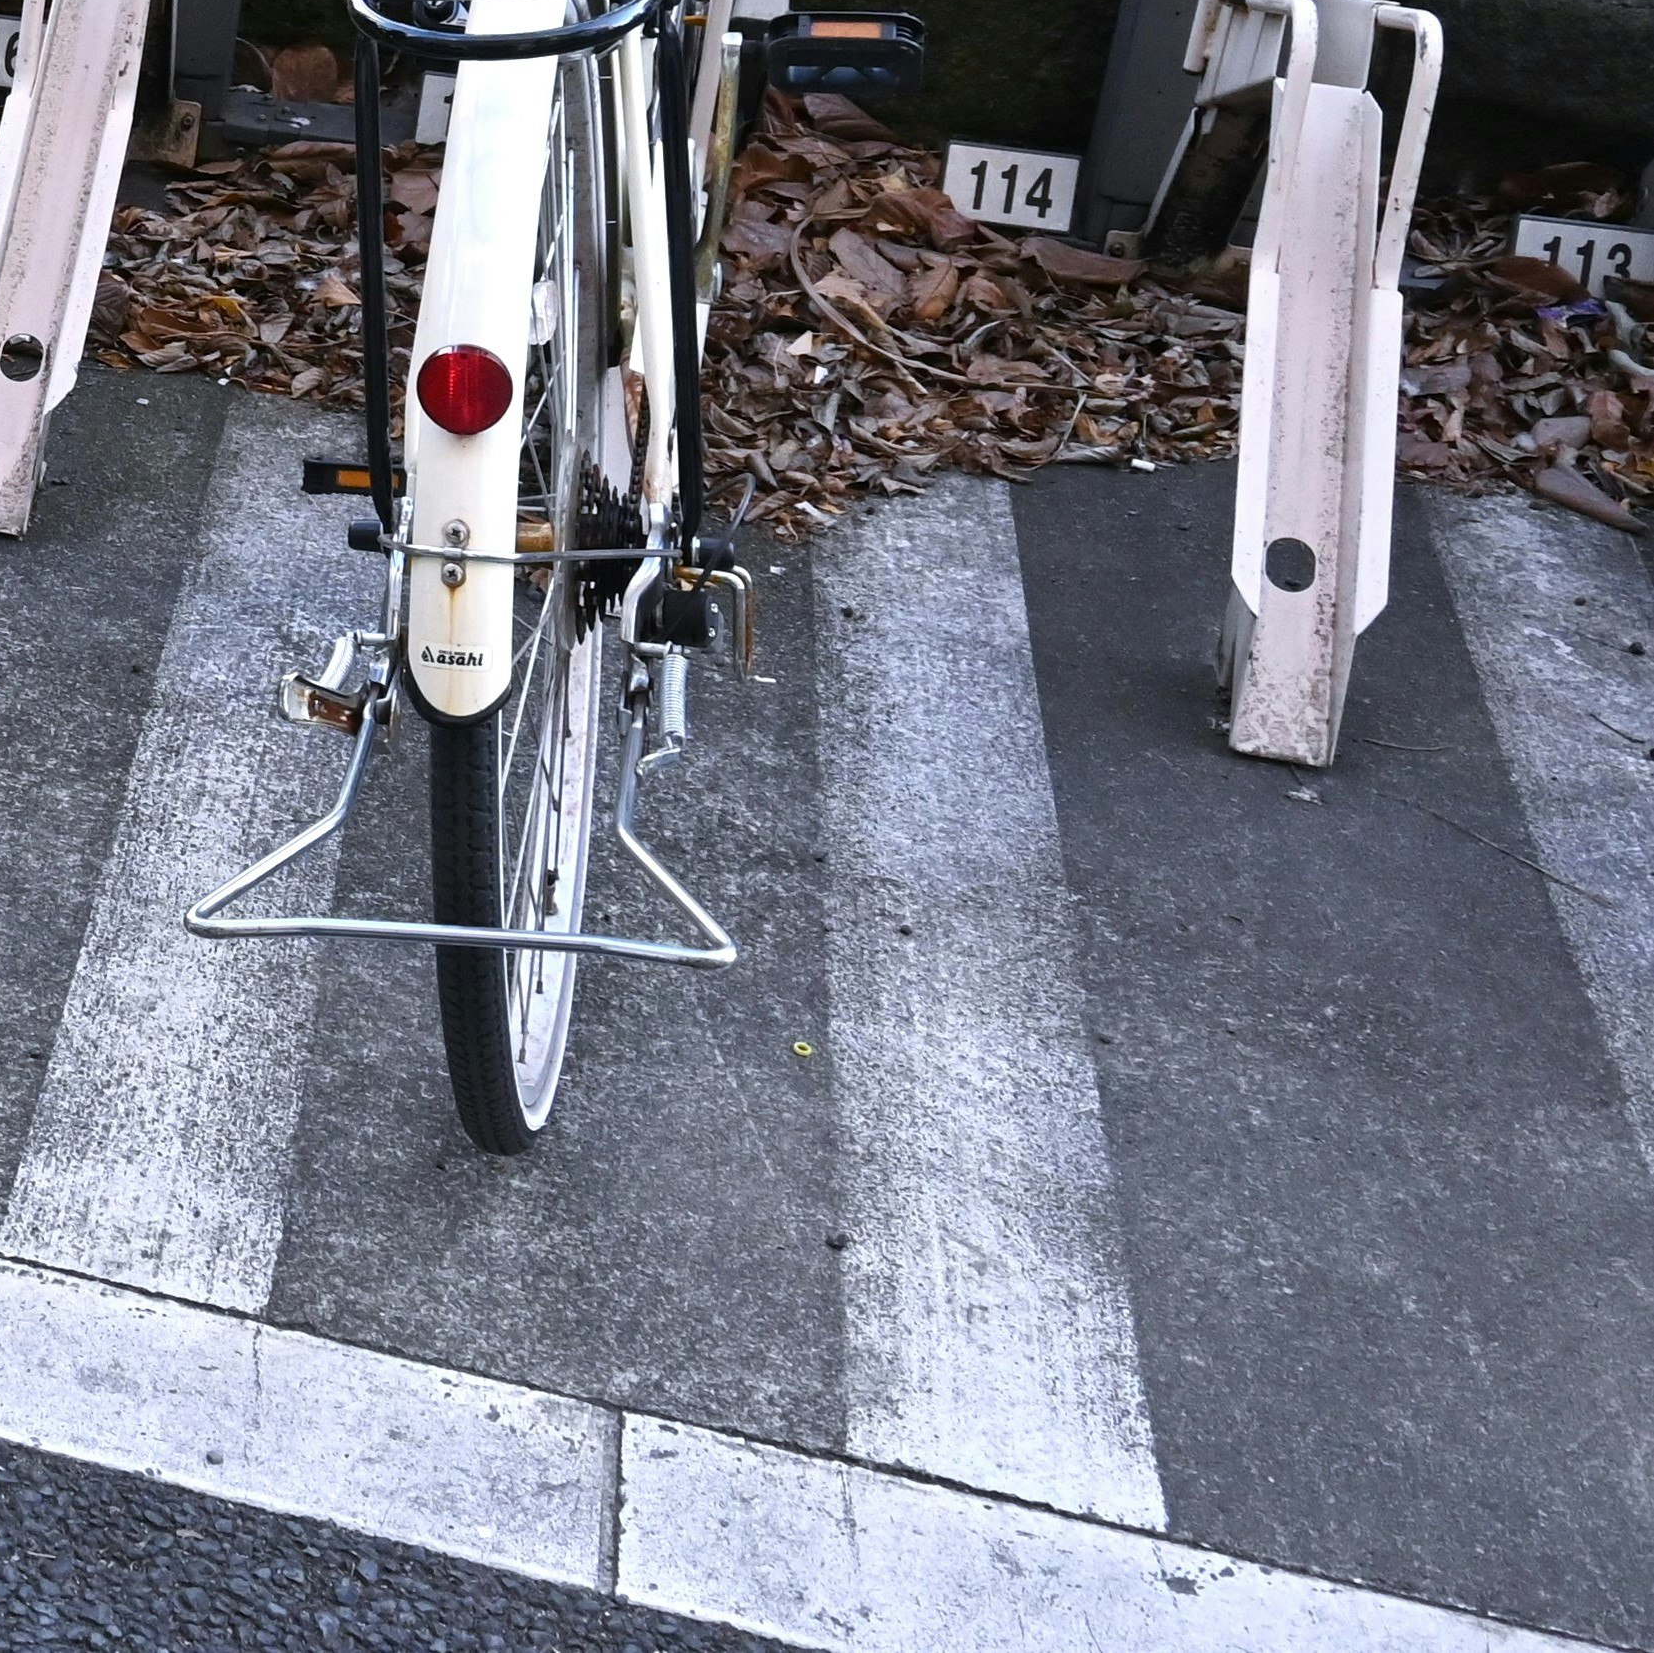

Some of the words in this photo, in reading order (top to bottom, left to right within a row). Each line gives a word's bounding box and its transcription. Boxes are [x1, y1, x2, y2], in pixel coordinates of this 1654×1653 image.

[970, 160, 1053, 219] 114
[1542, 235, 1633, 288] 113
[436, 652, 484, 667] asahi
